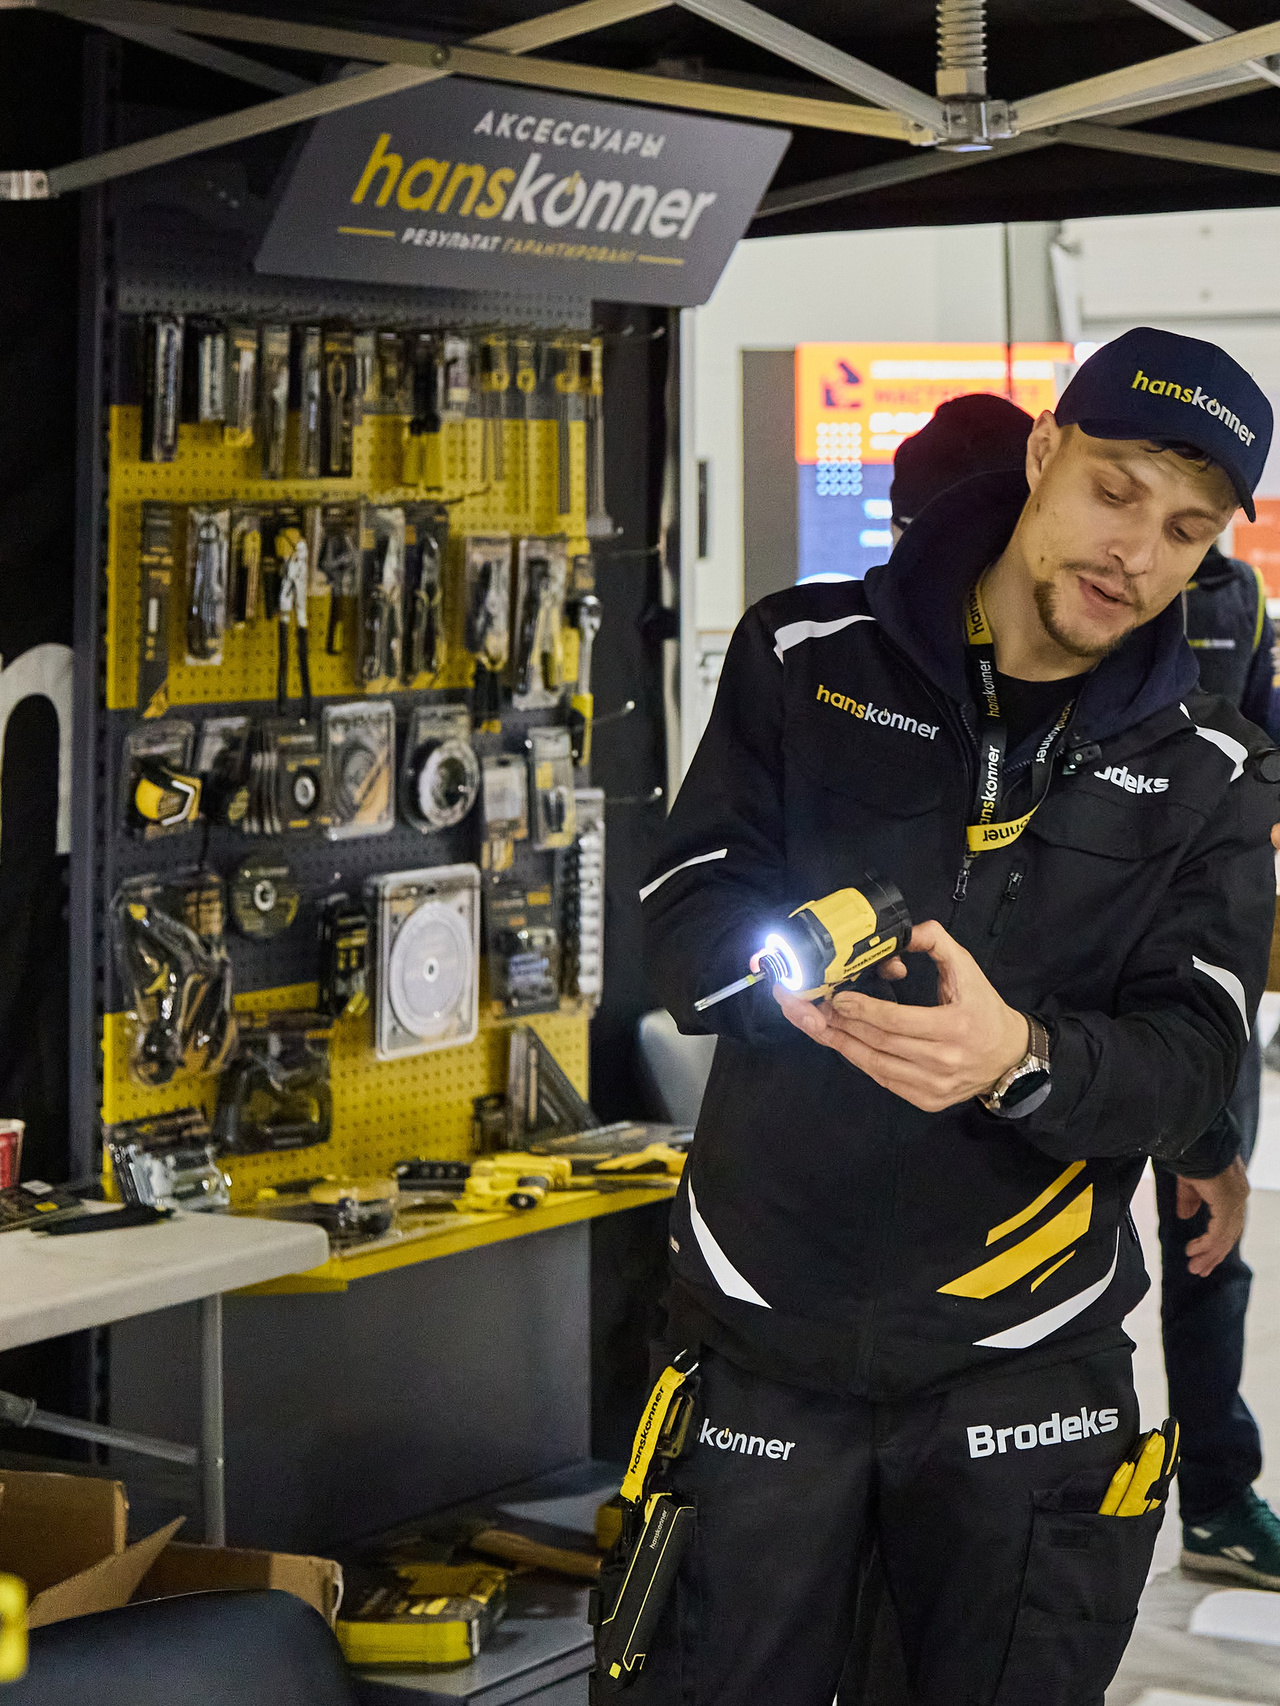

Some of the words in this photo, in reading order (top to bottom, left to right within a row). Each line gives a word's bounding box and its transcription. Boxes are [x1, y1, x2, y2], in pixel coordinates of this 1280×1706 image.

[474, 110, 666, 159] АКСЕССУАРЫ
[401, 227, 501, 253] РЕЗУЛЬТАТ
[966, 1406, 1119, 1459] Brodeks
